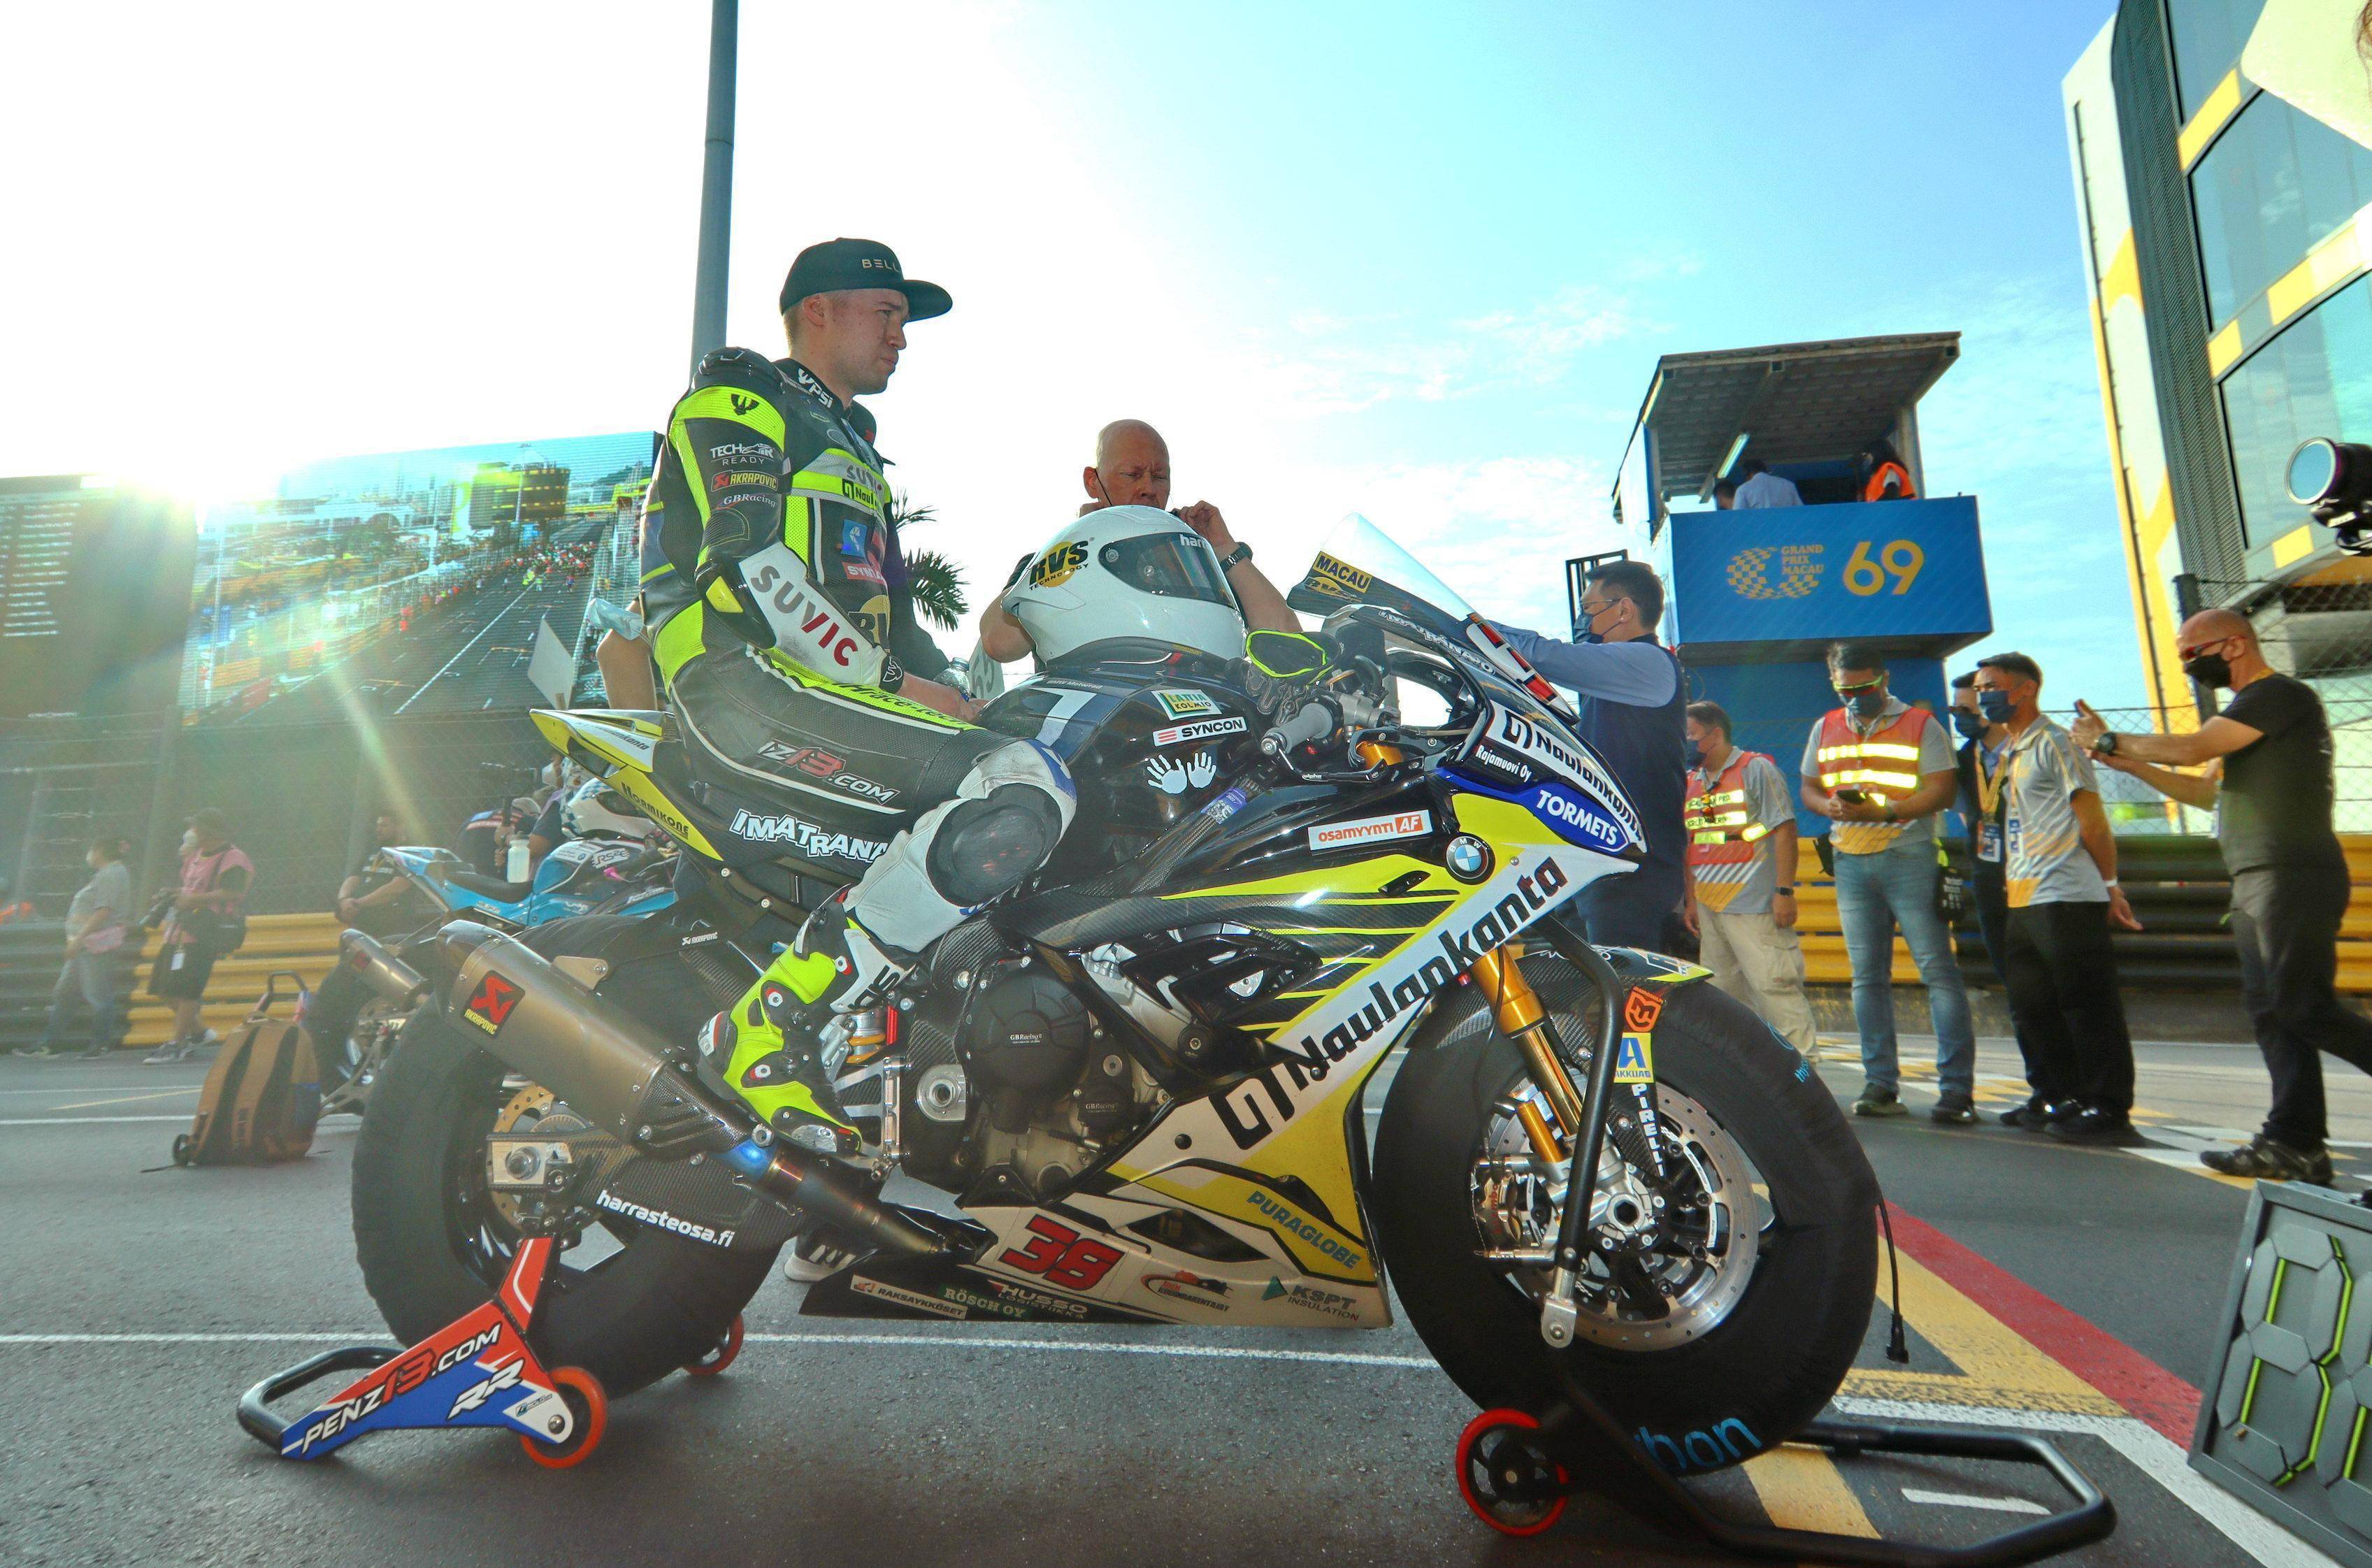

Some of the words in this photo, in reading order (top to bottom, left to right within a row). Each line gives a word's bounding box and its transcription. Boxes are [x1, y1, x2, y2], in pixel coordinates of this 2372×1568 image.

[861, 259, 900, 273] BELL
[722, 456, 765, 466] READY
[724, 494, 777, 508] GBRacing
[1029, 540, 1089, 586] RVS
[1783, 545, 1824, 554] GRAND
[1783, 556, 1810, 565] PRIX
[1315, 555, 1371, 591] MACAU
[1783, 564, 1825, 575] MACAU
[1842, 539, 1925, 596] 69
[750, 565, 858, 667] SUVIC
[1174, 701, 1212, 710] KOLMIO
[1181, 719, 1244, 738] SYNCON
[1474, 744, 1520, 774] Rajamuovi
[1519, 765, 1533, 783] Oy
[1398, 816, 1421, 833] AF
[1536, 789, 1618, 846] TORMETS
[691, 932, 719, 944] AKRAPOVIC
[1286, 856, 1569, 1095] Naulankanta
[464, 1009, 498, 1035] AKRAPOVIC
[1631, 1083, 1665, 1177] PIRELLI
[596, 1189, 735, 1248] harrasteosa.fi
[1246, 1190, 1363, 1269] PURAGLOBE
[998, 1214, 1126, 1291] 38
[943, 1287, 1000, 1312] RÖSCH
[1002, 1306, 1026, 1318] OY
[999, 1283, 1088, 1314] HUSSO
[1287, 1295, 1360, 1322] INSULATION
[1292, 1285, 1357, 1310] KSPT
[301, 1321, 503, 1454] PENZ13.COM
[446, 1358, 525, 1420] RR
